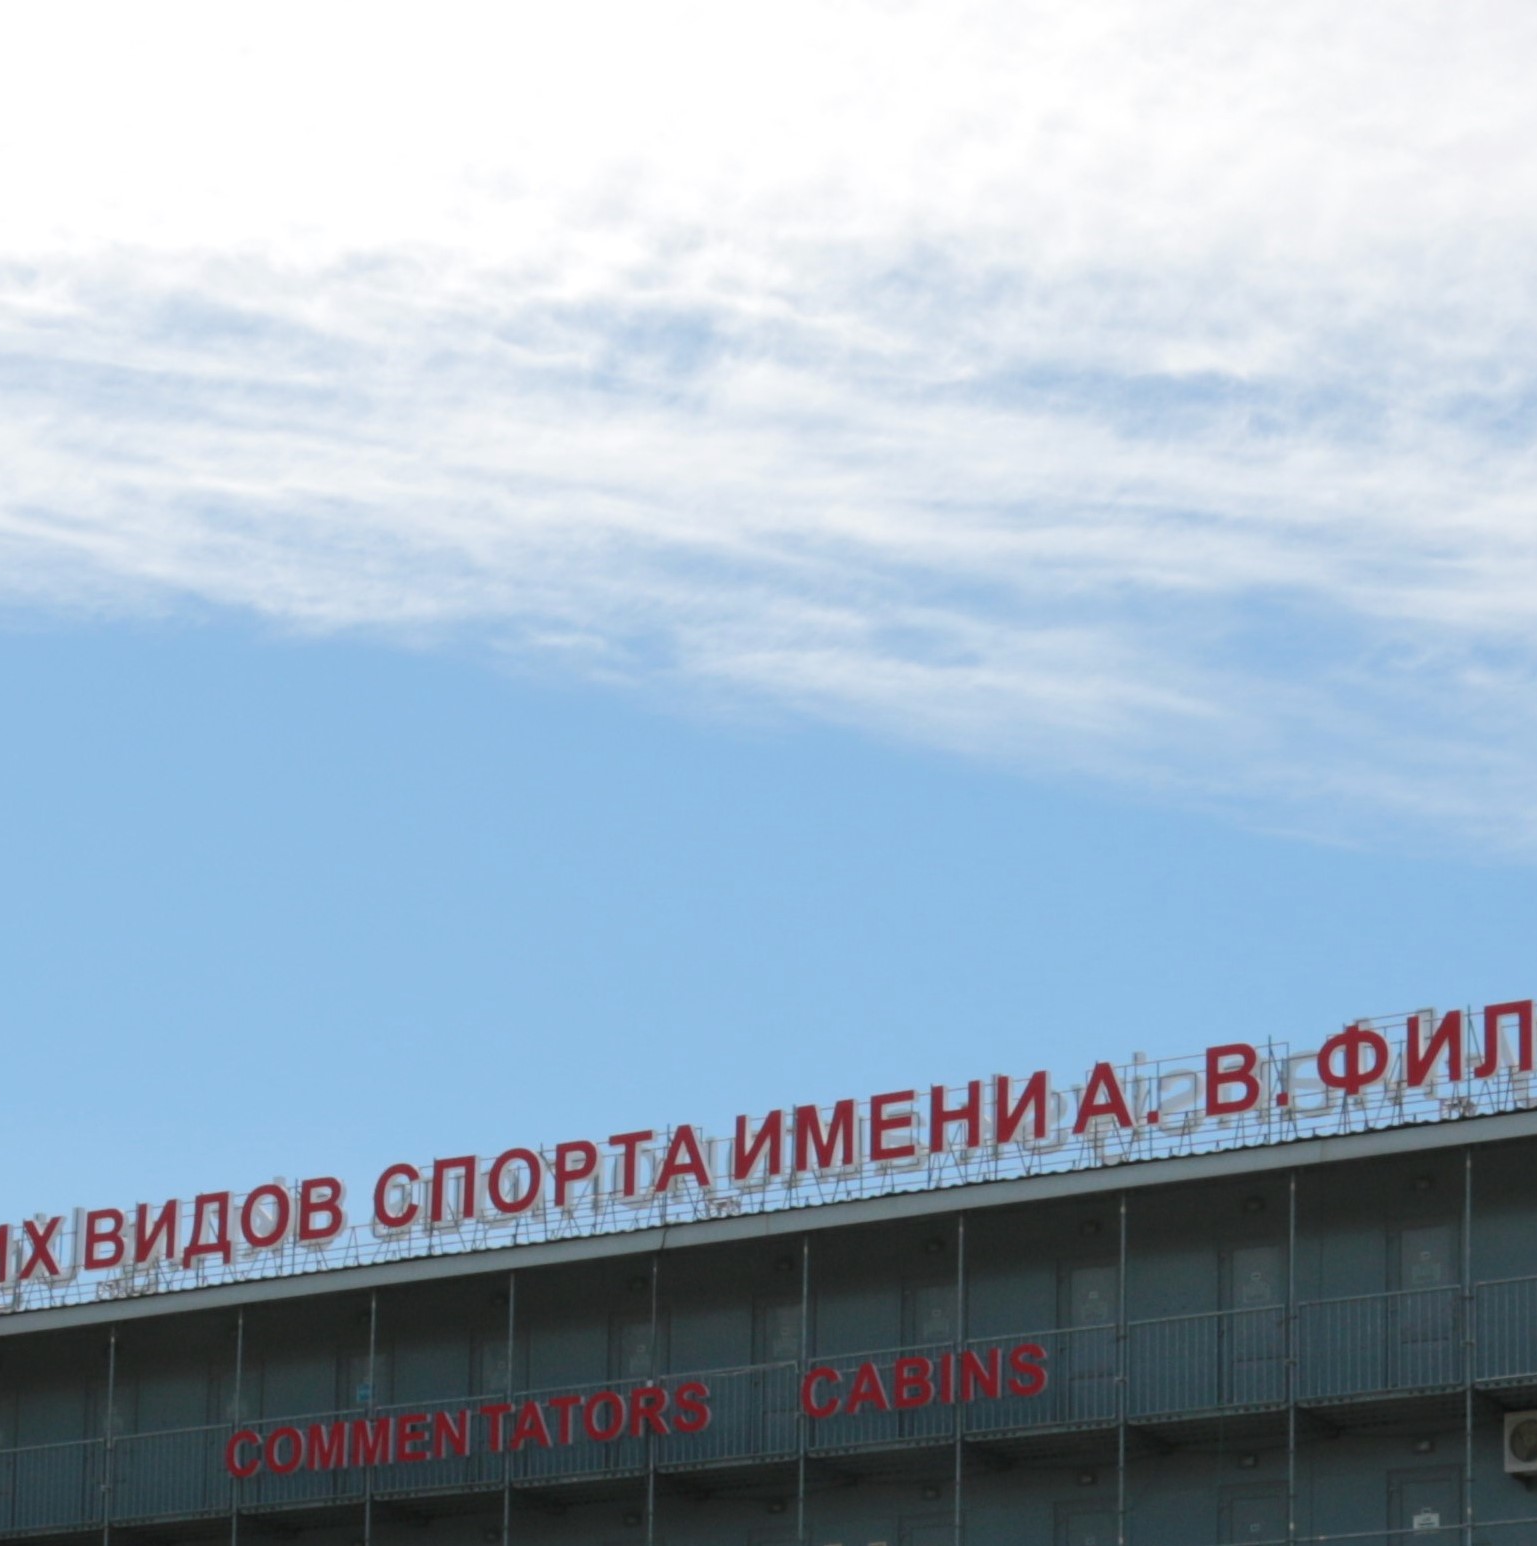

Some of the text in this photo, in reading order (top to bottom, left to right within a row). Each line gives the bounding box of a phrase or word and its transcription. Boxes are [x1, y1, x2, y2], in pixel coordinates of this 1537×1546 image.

[84, 1176, 344, 1271] ВИДОВ
[373, 1124, 712, 1229] СПОРТА
[733, 1070, 1048, 1181] ИМЕНИ
[1072, 1062, 1161, 1135] А.
[1205, 1042, 1291, 1118] В.
[225, 1343, 1048, 1479] COMMENTATORS CABINS
